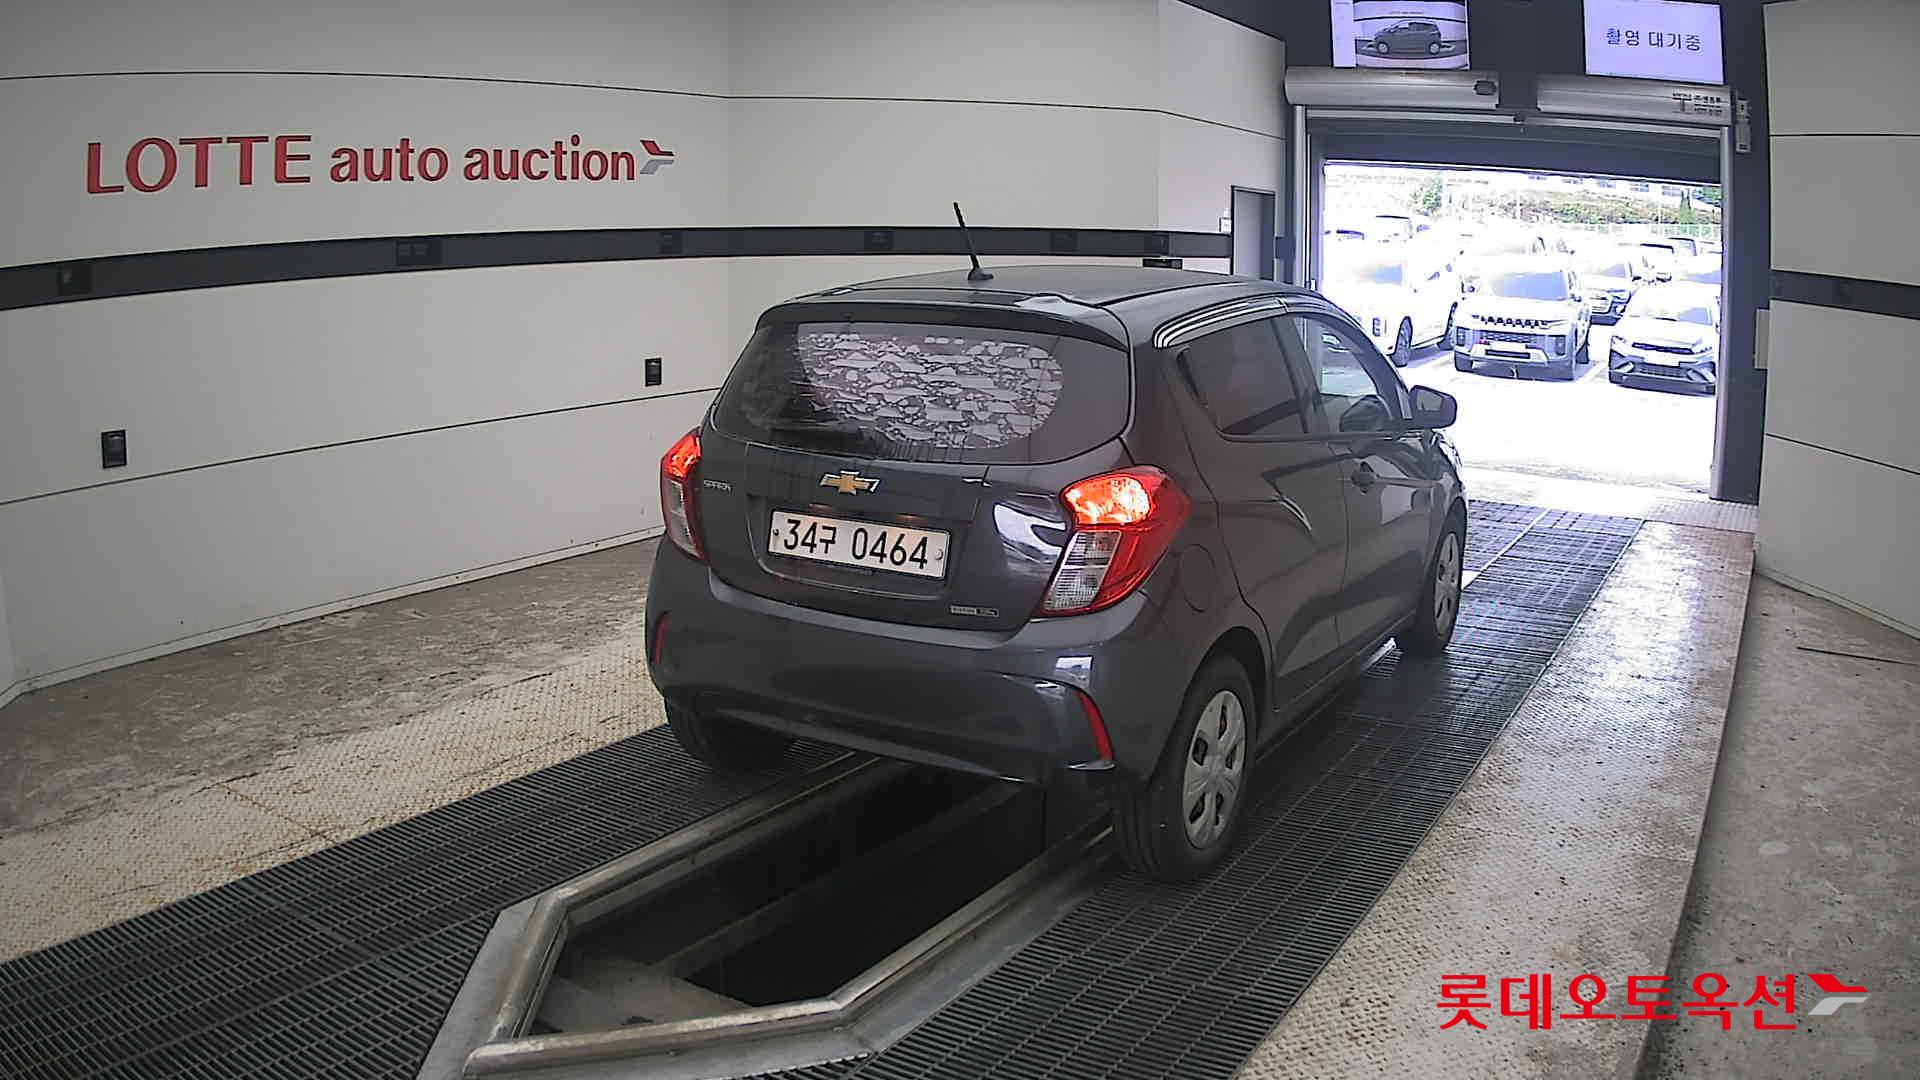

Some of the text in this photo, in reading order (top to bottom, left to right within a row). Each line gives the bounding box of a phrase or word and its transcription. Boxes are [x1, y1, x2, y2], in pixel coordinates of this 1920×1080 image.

[1607, 28, 1701, 51] 촬영 대기중
[87, 134, 636, 194] LOTTE auto auction
[783, 518, 929, 570] 34구 0464
